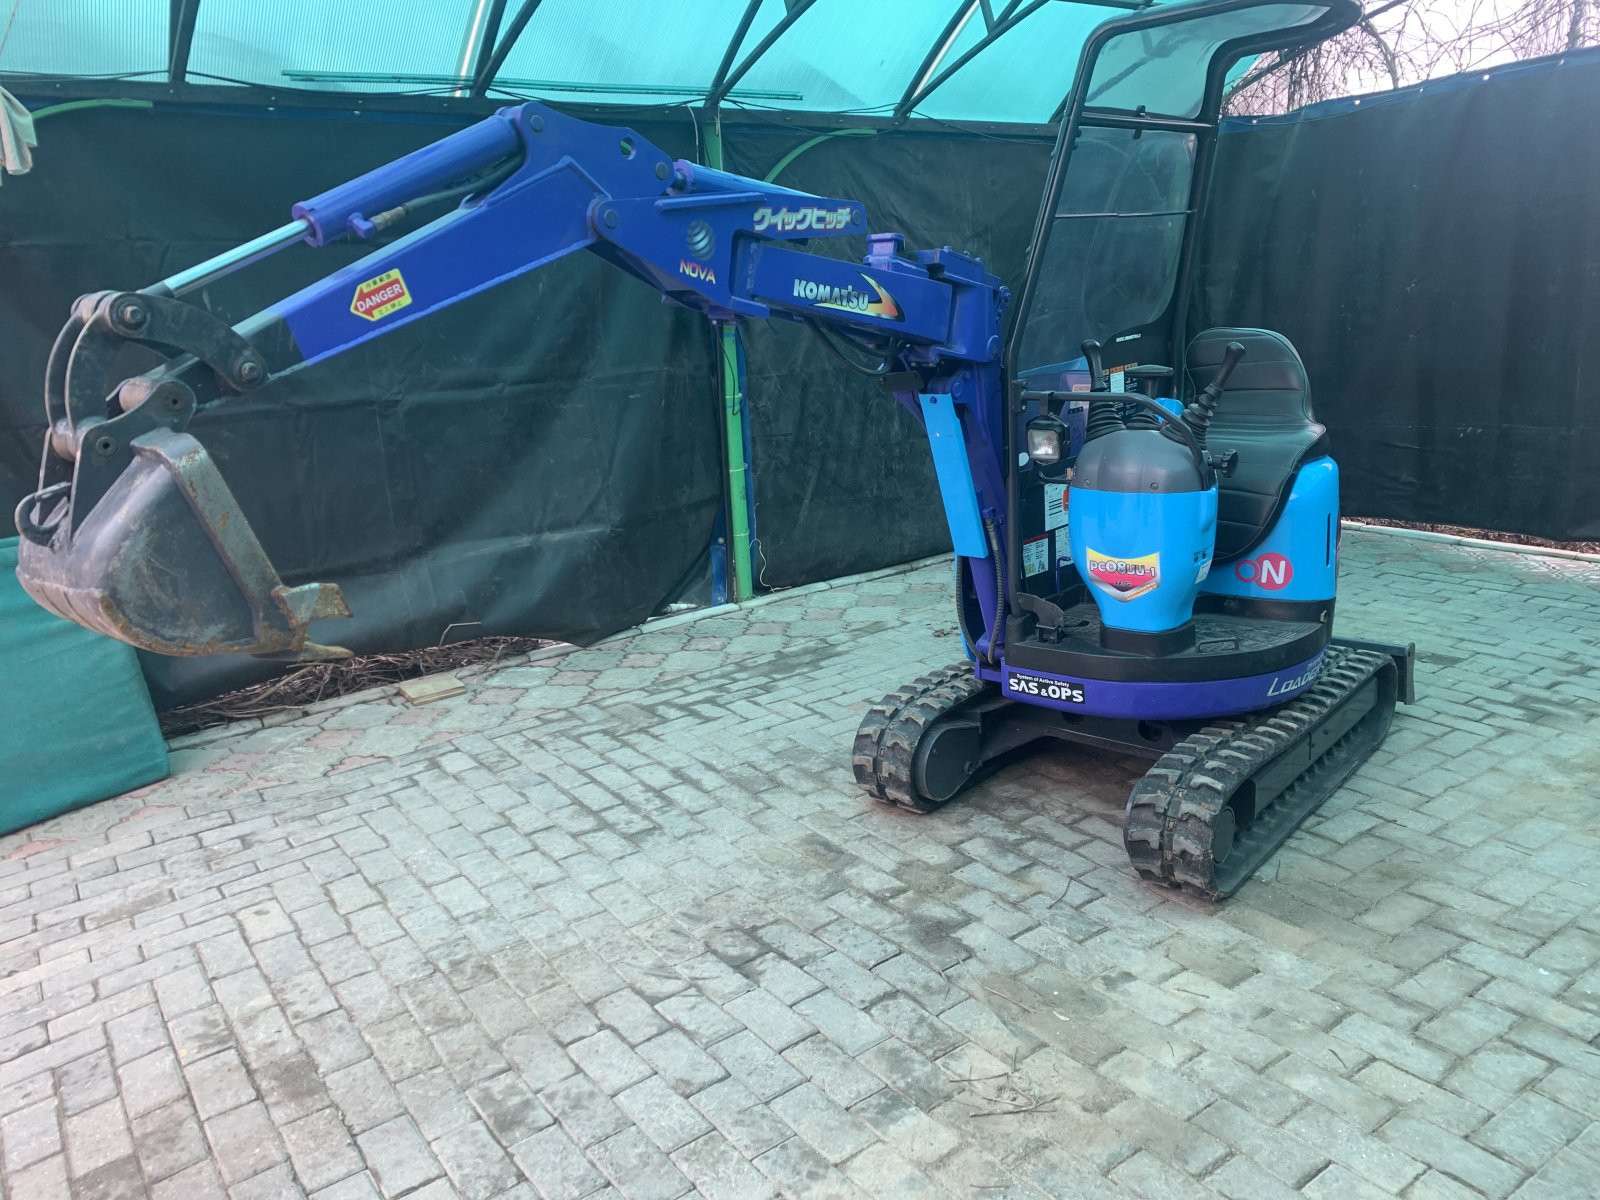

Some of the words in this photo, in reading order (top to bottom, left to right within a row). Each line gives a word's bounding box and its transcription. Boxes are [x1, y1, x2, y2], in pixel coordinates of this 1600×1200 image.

[753, 207, 851, 231] クイックヒッチ
[679, 259, 716, 284] NOVA
[356, 283, 402, 312] DANGER
[793, 278, 869, 311] KOMATSU
[1090, 560, 1156, 577] PC08UU-1
[1009, 678, 1038, 694] SAS
[1016, 673, 1033, 681] System
[1054, 680, 1070, 688] Safety
